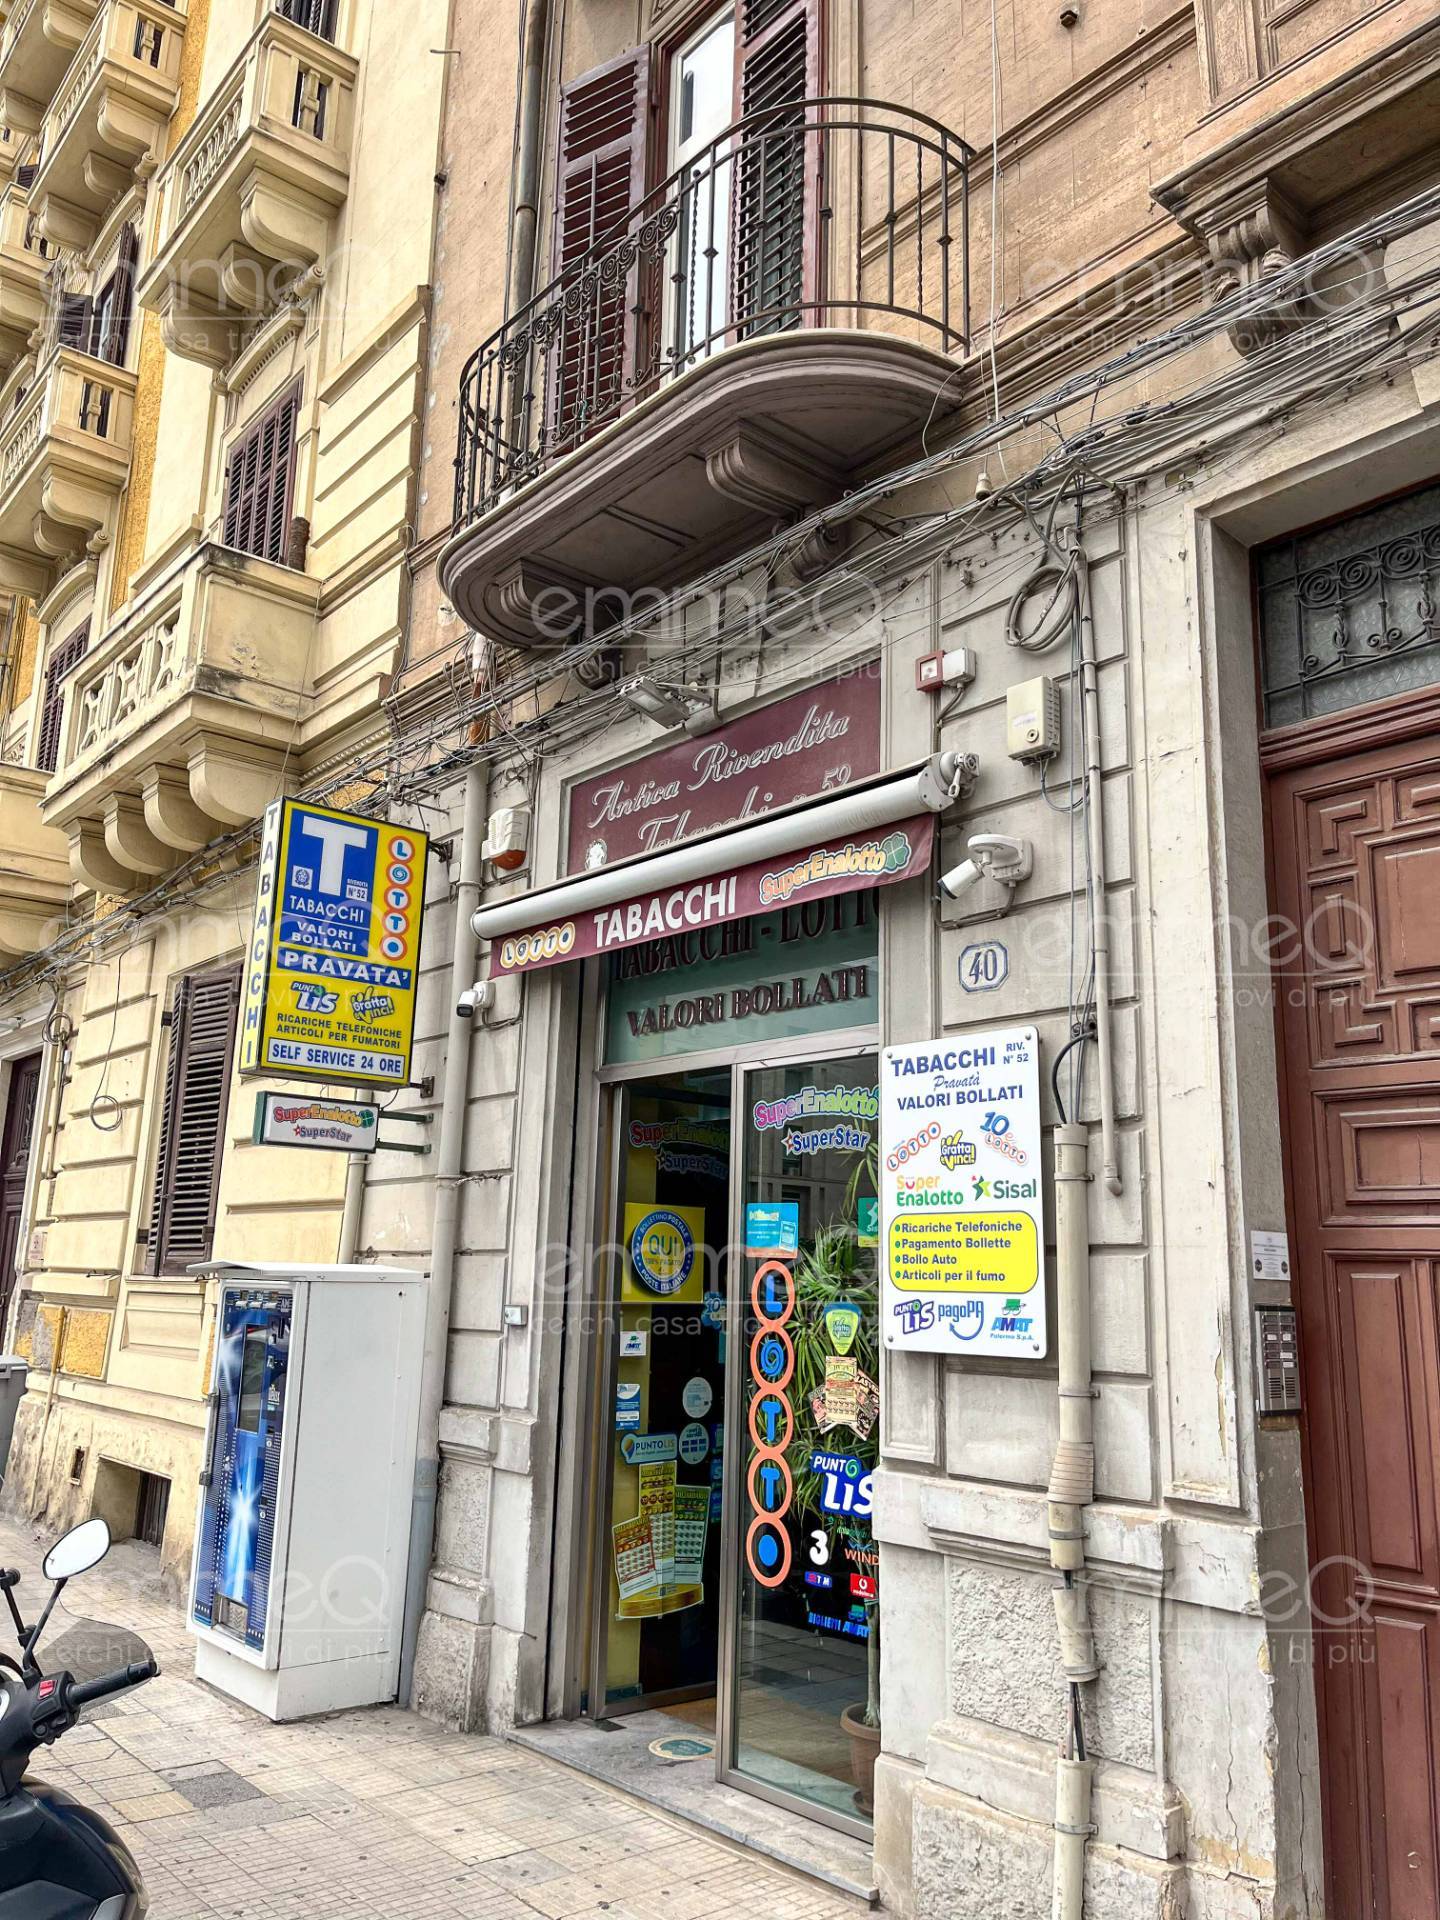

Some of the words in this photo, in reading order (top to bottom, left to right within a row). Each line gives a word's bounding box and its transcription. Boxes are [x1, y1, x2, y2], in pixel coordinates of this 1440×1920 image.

[588, 780, 681, 829] Antica
[688, 704, 850, 791] Rivendita
[302, 815, 368, 897] T
[289, 895, 364, 923] TABACCHI
[500, 921, 576, 969] LOTTO
[593, 875, 737, 948] TABACCHI
[761, 845, 886, 904] SuperEnalotto
[246, 806, 278, 1063] TABACCHI
[291, 931, 356, 953] BOLLATI
[297, 921, 353, 941] VALORI
[969, 949, 997, 984] 40
[627, 990, 724, 1037] VALORI
[730, 965, 871, 1020] BOLLATI
[276, 1024, 324, 1039] ARTICOLI
[328, 1031, 347, 1042] PER
[352, 1035, 400, 1049] FUMATORI
[277, 1013, 332, 1029] RICARICHE
[337, 1021, 402, 1039] TELEFONICHE
[272, 1043, 301, 1060] SELF
[307, 1048, 355, 1068] SERVICE
[360, 1055, 374, 1071] 24
[379, 1058, 401, 1073] ORE
[891, 1046, 995, 1077] TABACCHI
[1006, 1041, 1025, 1052] RIV.
[1017, 1052, 1029, 1063] 52
[933, 1071, 980, 1091] Pravatà
[755, 1088, 878, 1127] SuperEnalotto
[897, 1093, 950, 1111] VALORI
[956, 1084, 1023, 1105] BOLLATI
[299, 1126, 353, 1143] SuperStar
[980, 1111, 1010, 1136] 10
[793, 1126, 869, 1151] SuperStar
[887, 1121, 942, 1172] LOTTO
[941, 1142, 972, 1156] Gratta
[896, 1190, 964, 1207] Enalotto
[993, 1178, 1037, 1199] Sisal
[902, 1223, 952, 1233] Ricariche
[956, 1221, 1022, 1232] Telefoniche
[648, 1234, 678, 1256] QUI
[902, 1239, 962, 1251] Pagamento
[965, 1238, 1011, 1248] Bollette
[902, 1254, 929, 1265] Bollo
[932, 1254, 957, 1265] Auto
[902, 1270, 941, 1280] Articoli
[944, 1272, 963, 1283] per
[966, 1270, 973, 1281] il
[976, 1271, 1006, 1281] fumo
[938, 1301, 984, 1323] pagoPA
[991, 1317, 1034, 1332] AMAT
[746, 1260, 797, 1588] LOTTO
[809, 1529, 829, 1566] 3
[844, 1549, 880, 1566] WIND
